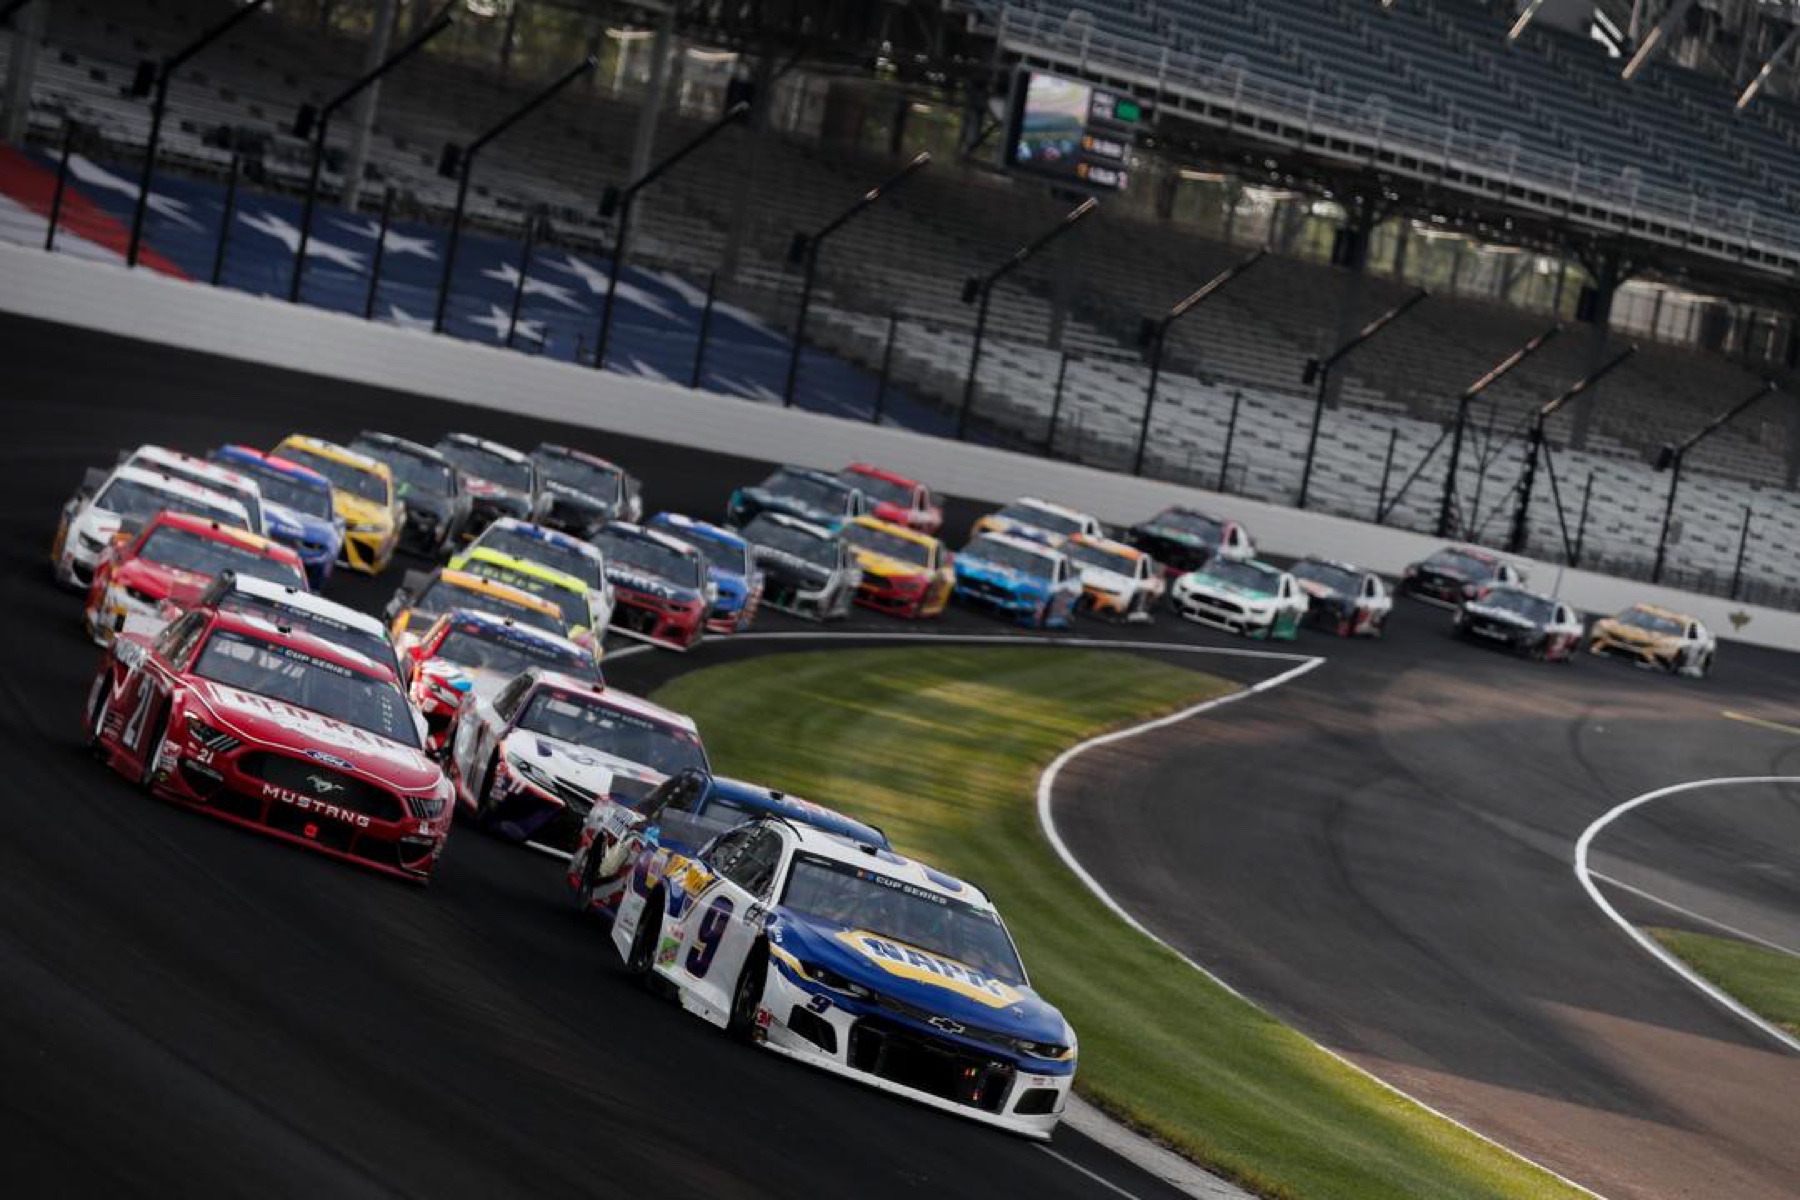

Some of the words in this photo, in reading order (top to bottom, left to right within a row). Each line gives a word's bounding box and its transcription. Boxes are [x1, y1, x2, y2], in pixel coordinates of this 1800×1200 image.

[285, 649, 310, 661] CUP
[311, 658, 352, 678] SERIES
[197, 748, 214, 764] 21
[262, 782, 371, 828] MUSTANG
[876, 875, 902, 888] CUP
[903, 884, 948, 905] SERIES
[684, 894, 734, 979] 9
[806, 994, 832, 1014] 9
